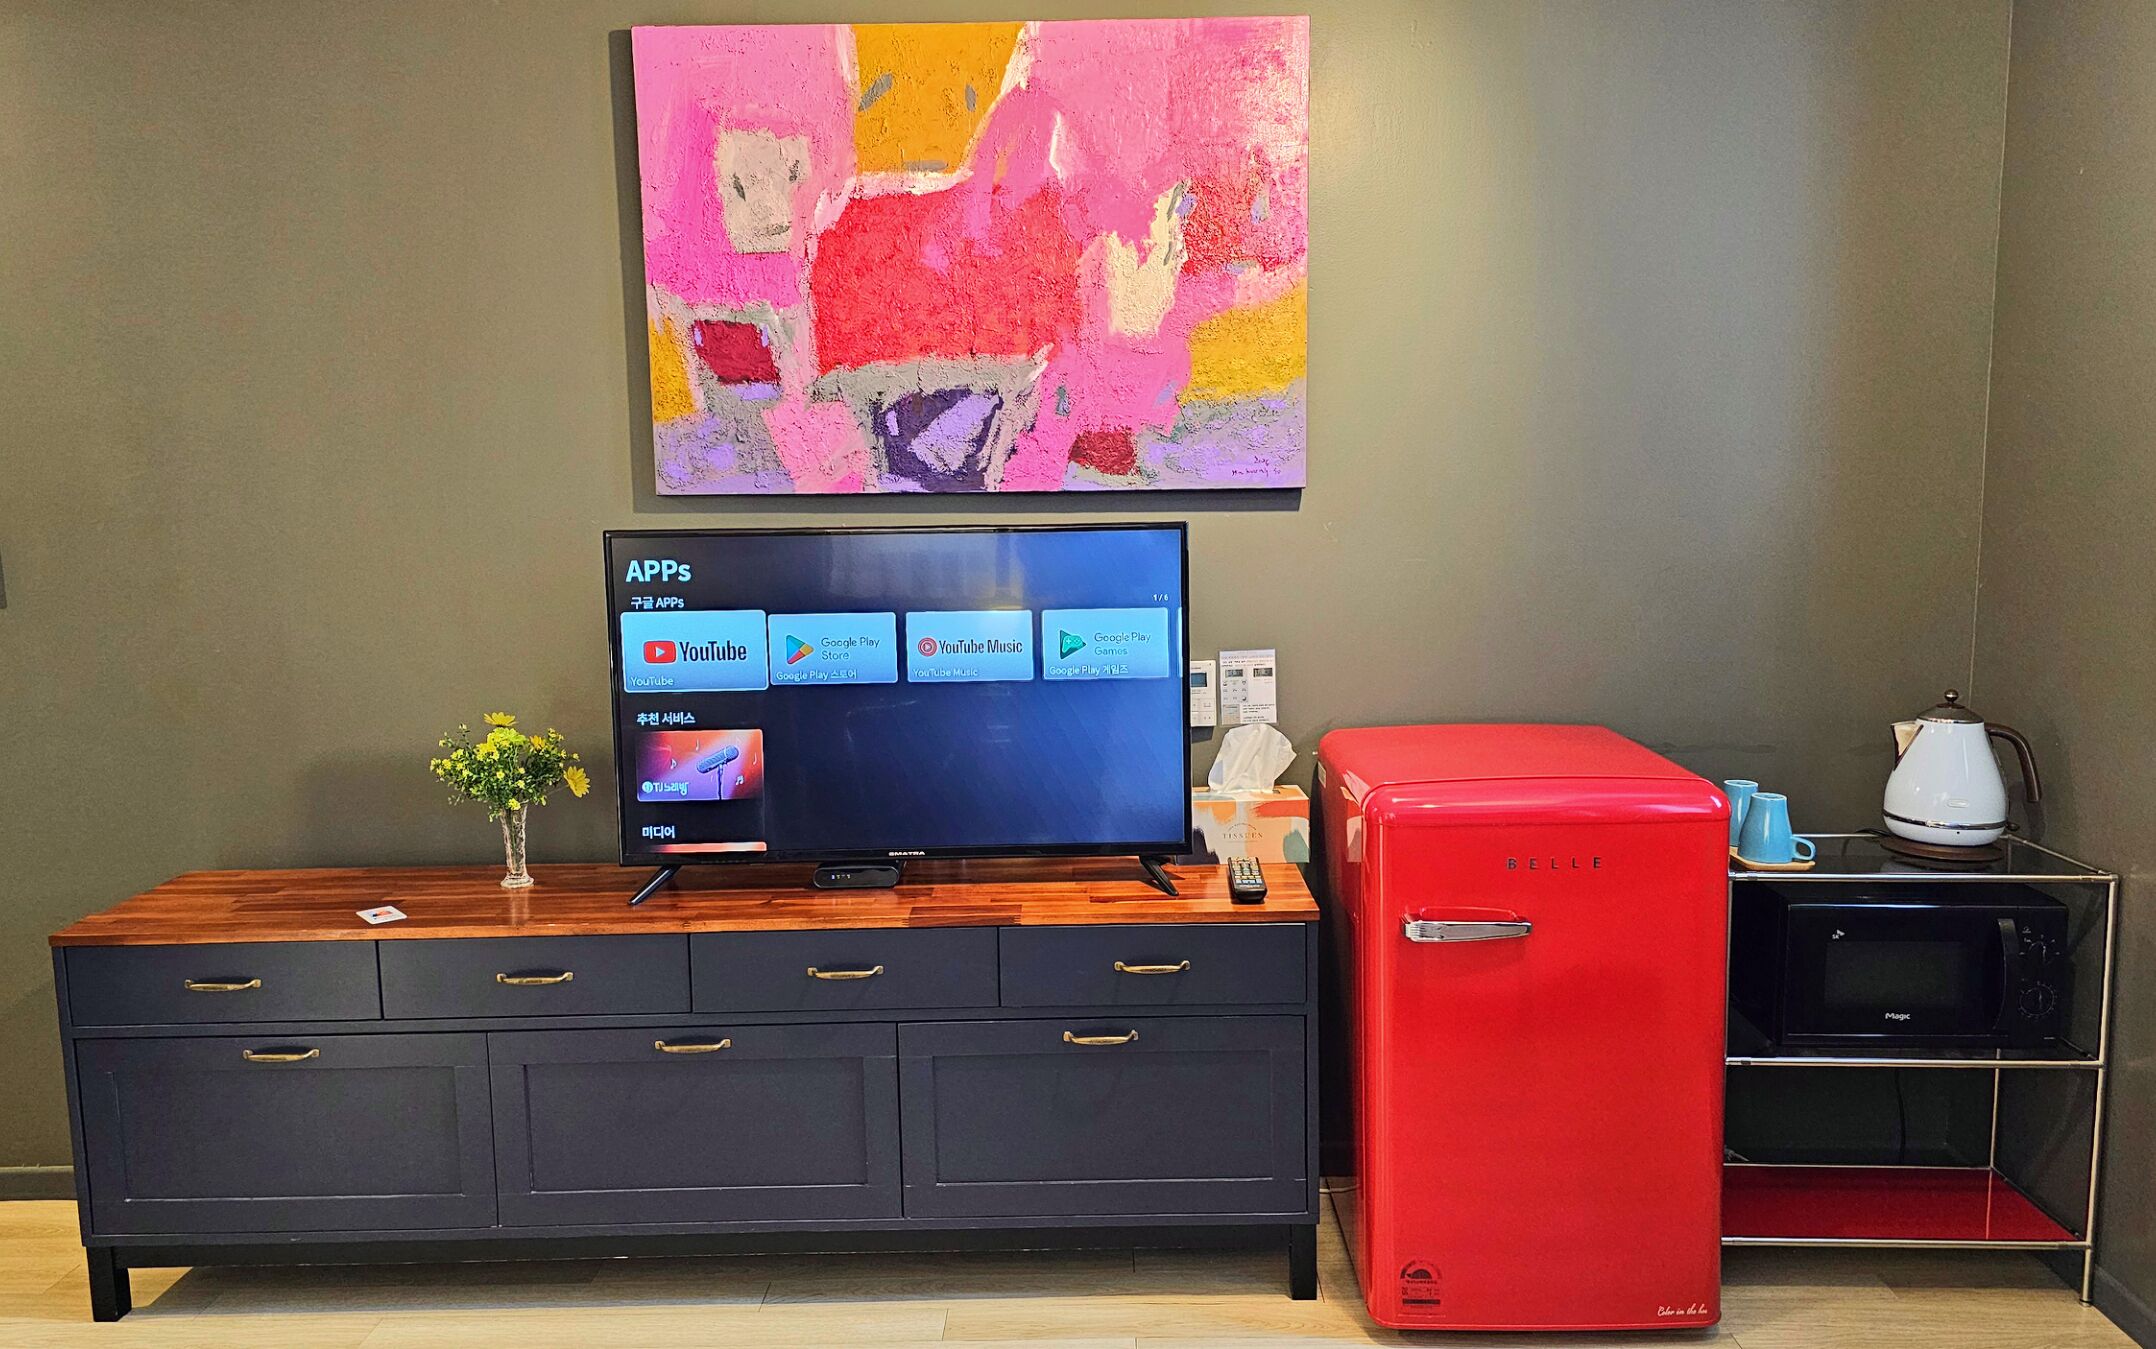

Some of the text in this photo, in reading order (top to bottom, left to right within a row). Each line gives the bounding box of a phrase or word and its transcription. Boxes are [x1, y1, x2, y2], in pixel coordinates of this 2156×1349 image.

[625, 559, 691, 583] APPs
[631, 596, 684, 609] 구글 APPs
[821, 637, 880, 650] Google Play
[1094, 632, 1151, 645] Google Play
[679, 641, 747, 662] YouTube
[938, 639, 1023, 655] YouTube Music
[1094, 647, 1128, 656] Games
[821, 650, 849, 661] Store
[776, 669, 857, 682] Google Play 스토어
[912, 667, 978, 677] YouTube Music
[1049, 663, 1128, 677] Google Play 게임즈
[631, 676, 674, 686] YouTube
[637, 711, 695, 726] 추천 서비스
[642, 826, 675, 839] 미디어
[1508, 857, 1601, 870] BELLE
[1885, 1012, 1911, 1021] Magic
